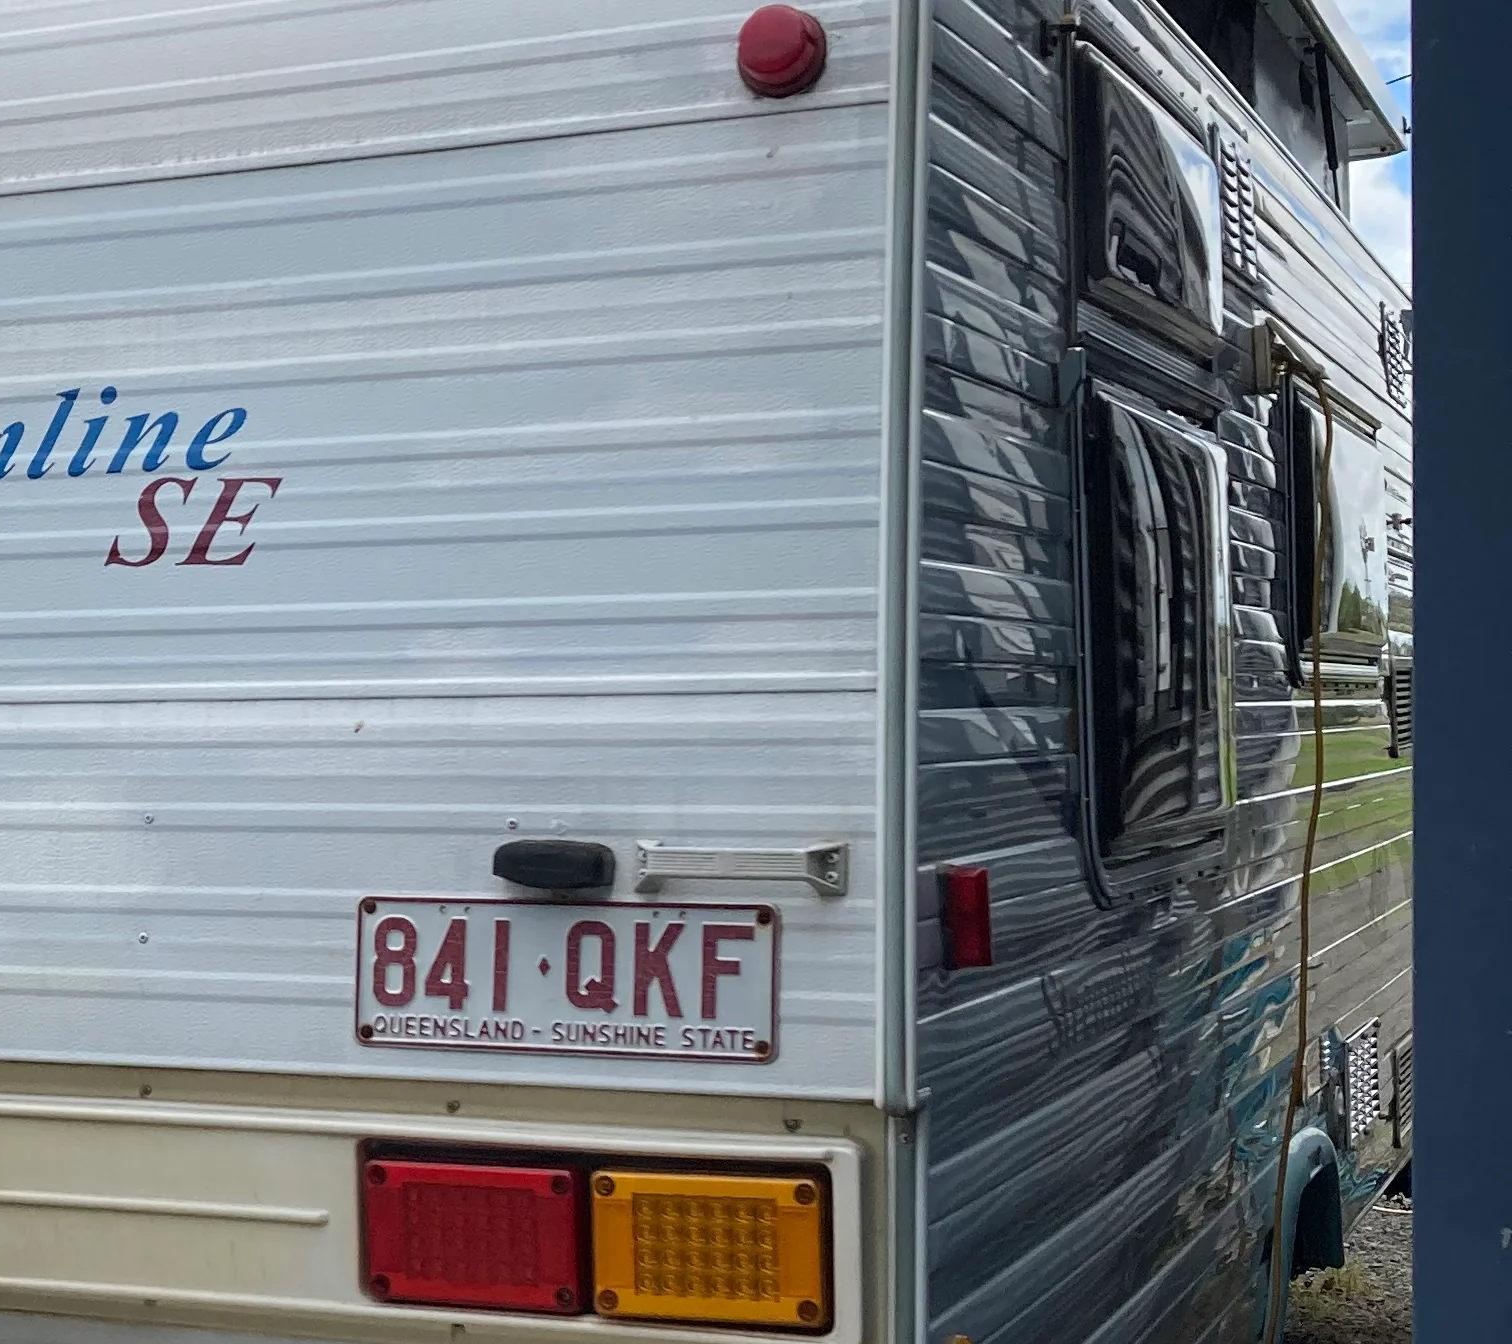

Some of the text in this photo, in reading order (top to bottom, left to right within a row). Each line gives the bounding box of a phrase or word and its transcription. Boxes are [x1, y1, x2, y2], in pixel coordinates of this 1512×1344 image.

[103, 476, 283, 567] SE
[373, 1013, 524, 1042] QUEENSLAND
[551, 1021, 666, 1047] SUNSHINE
[681, 1026, 756, 1051] STATE
